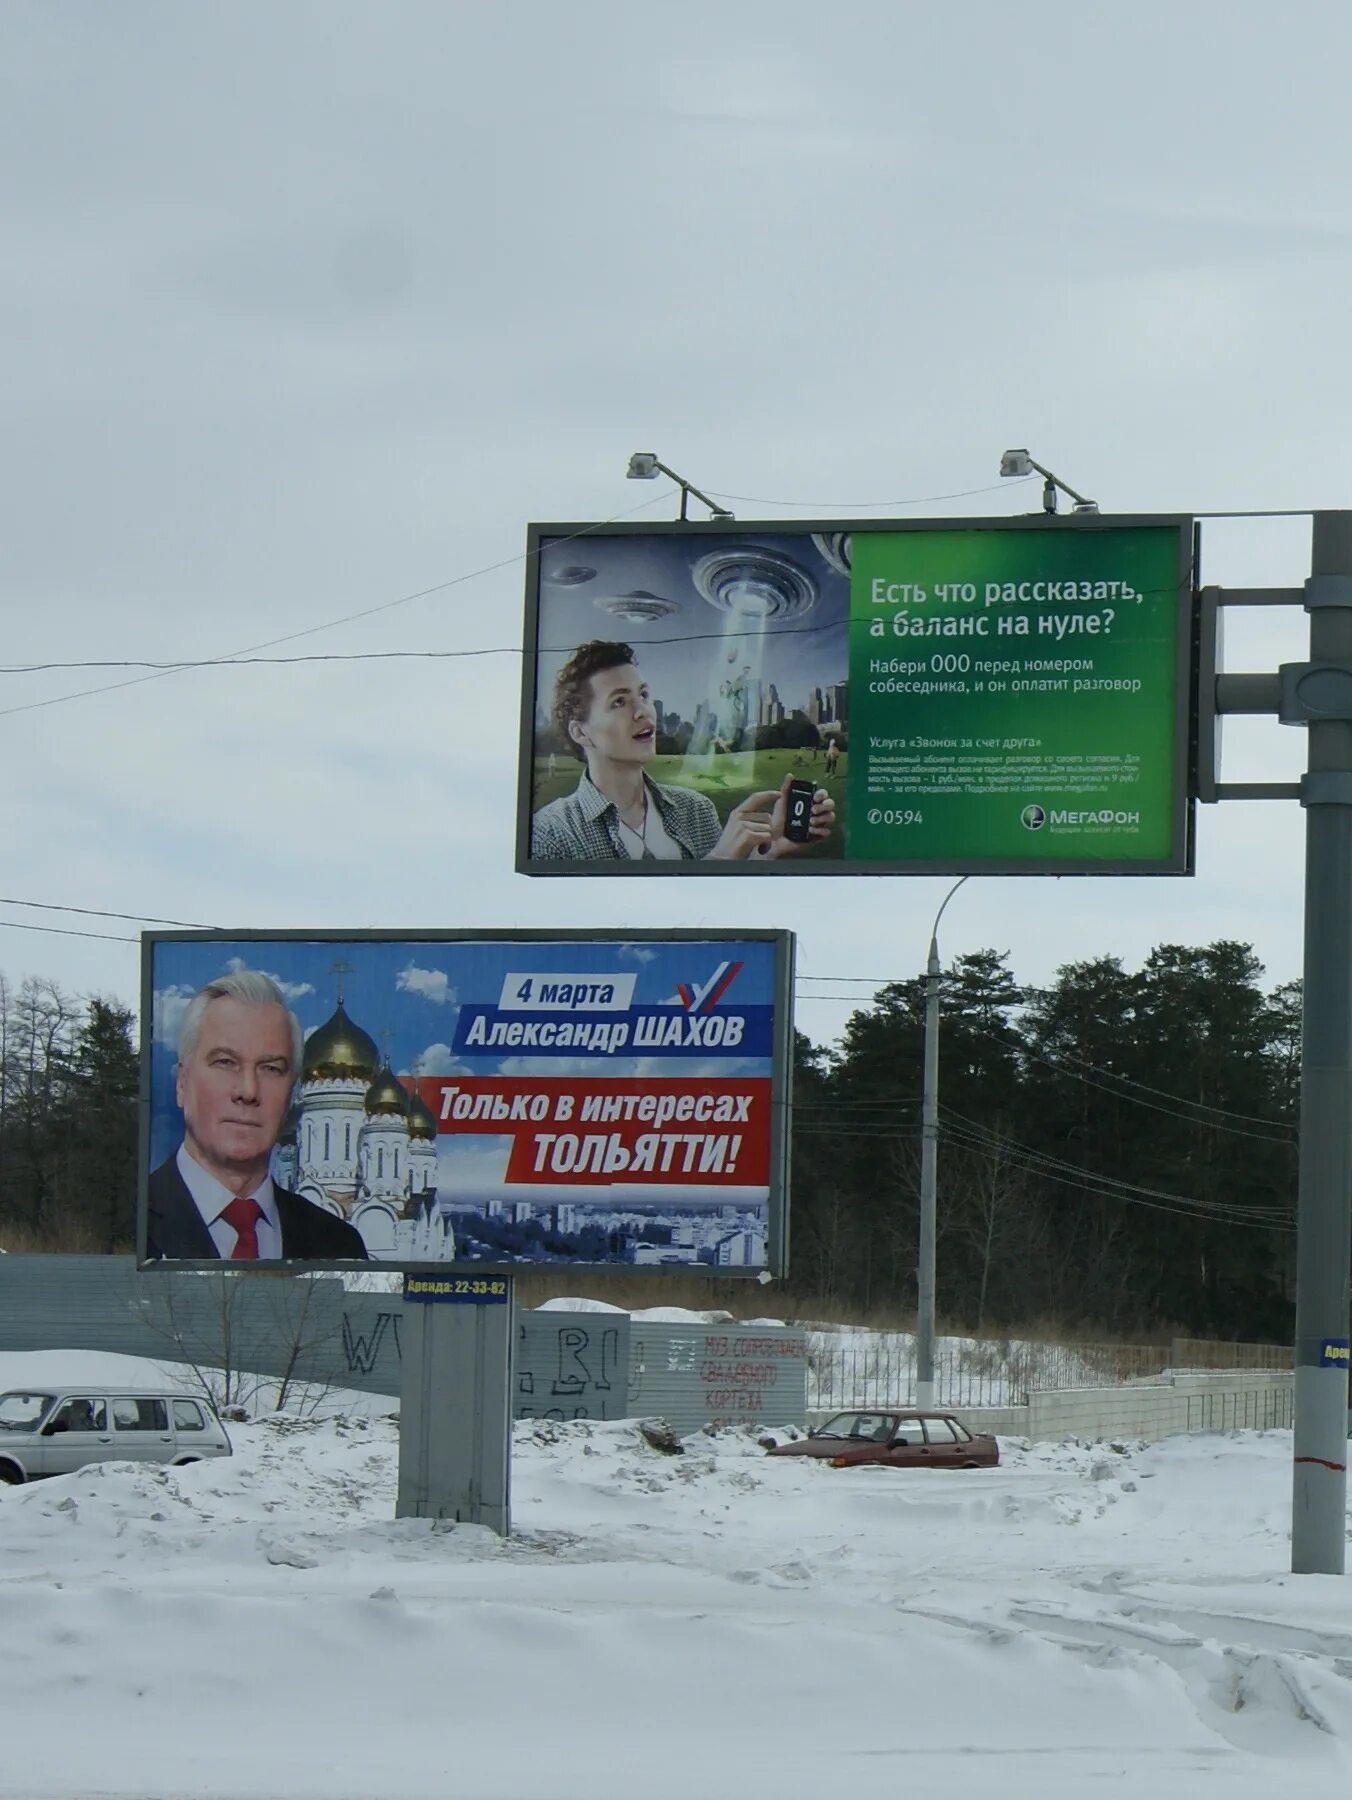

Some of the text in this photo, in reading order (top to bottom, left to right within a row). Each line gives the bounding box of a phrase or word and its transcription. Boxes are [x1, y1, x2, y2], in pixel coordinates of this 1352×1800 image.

[870, 578, 1144, 607] Есть что рассказать,
[869, 608, 1115, 641] а баланс на нуле?
[870, 654, 1093, 676] Набери 000 перед номером
[869, 678, 1141, 695] собеседника, и он оплатит разговор
[869, 736, 906, 750] Услуга
[961, 739, 973, 748] за
[795, 800, 804, 816] 0
[884, 810, 923, 824] 0594
[516, 978, 615, 1009] 4 марта
[465, 1015, 746, 1053] Александр ШАХОВ
[439, 1086, 753, 1129] Только в интересах
[533, 1133, 743, 1174] ТОЛЬЯТТИ!
[408, 1280, 505, 1295] Аренда: 22-33-82
